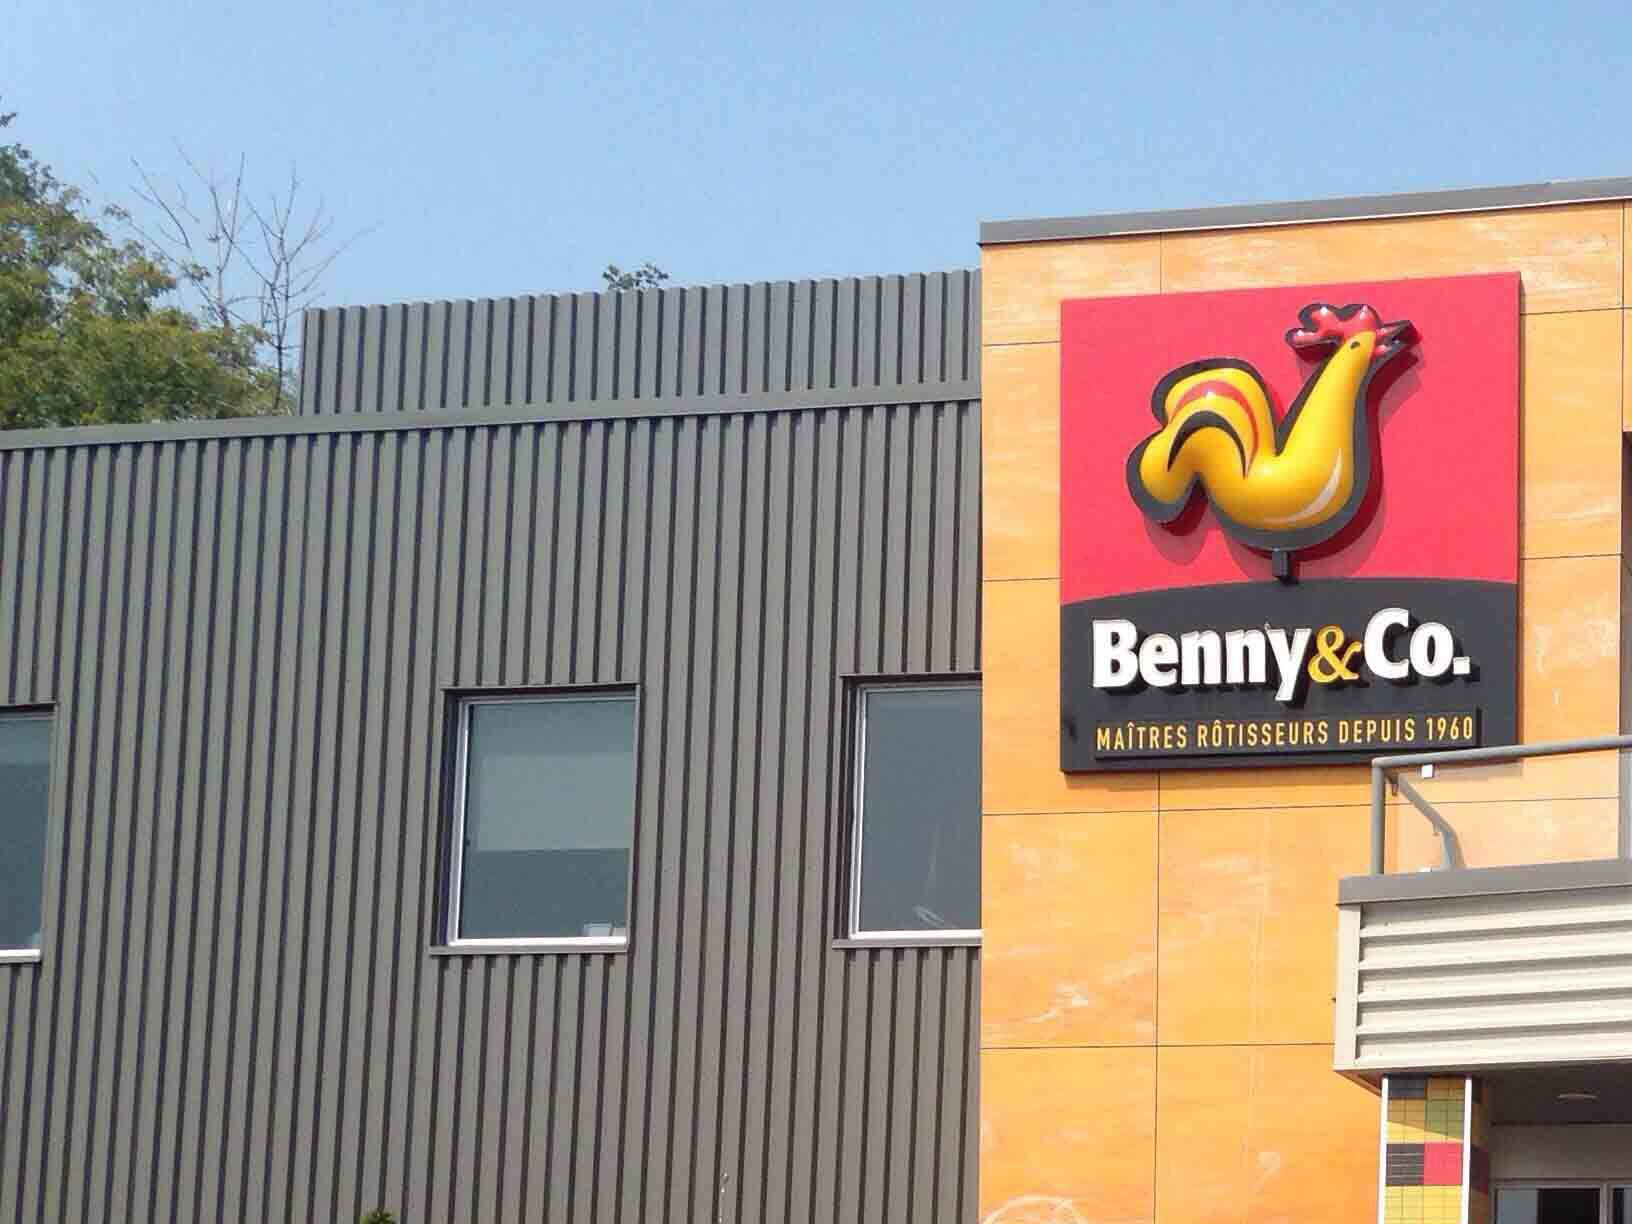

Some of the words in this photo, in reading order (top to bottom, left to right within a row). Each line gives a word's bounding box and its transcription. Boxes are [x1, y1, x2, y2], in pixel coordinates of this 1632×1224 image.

[1096, 720, 1188, 751] MAÎTRES
[1197, 718, 1330, 747] RÔTISSEURS
[1339, 718, 1415, 744] DEPUIS
[1426, 716, 1474, 741] 1960
